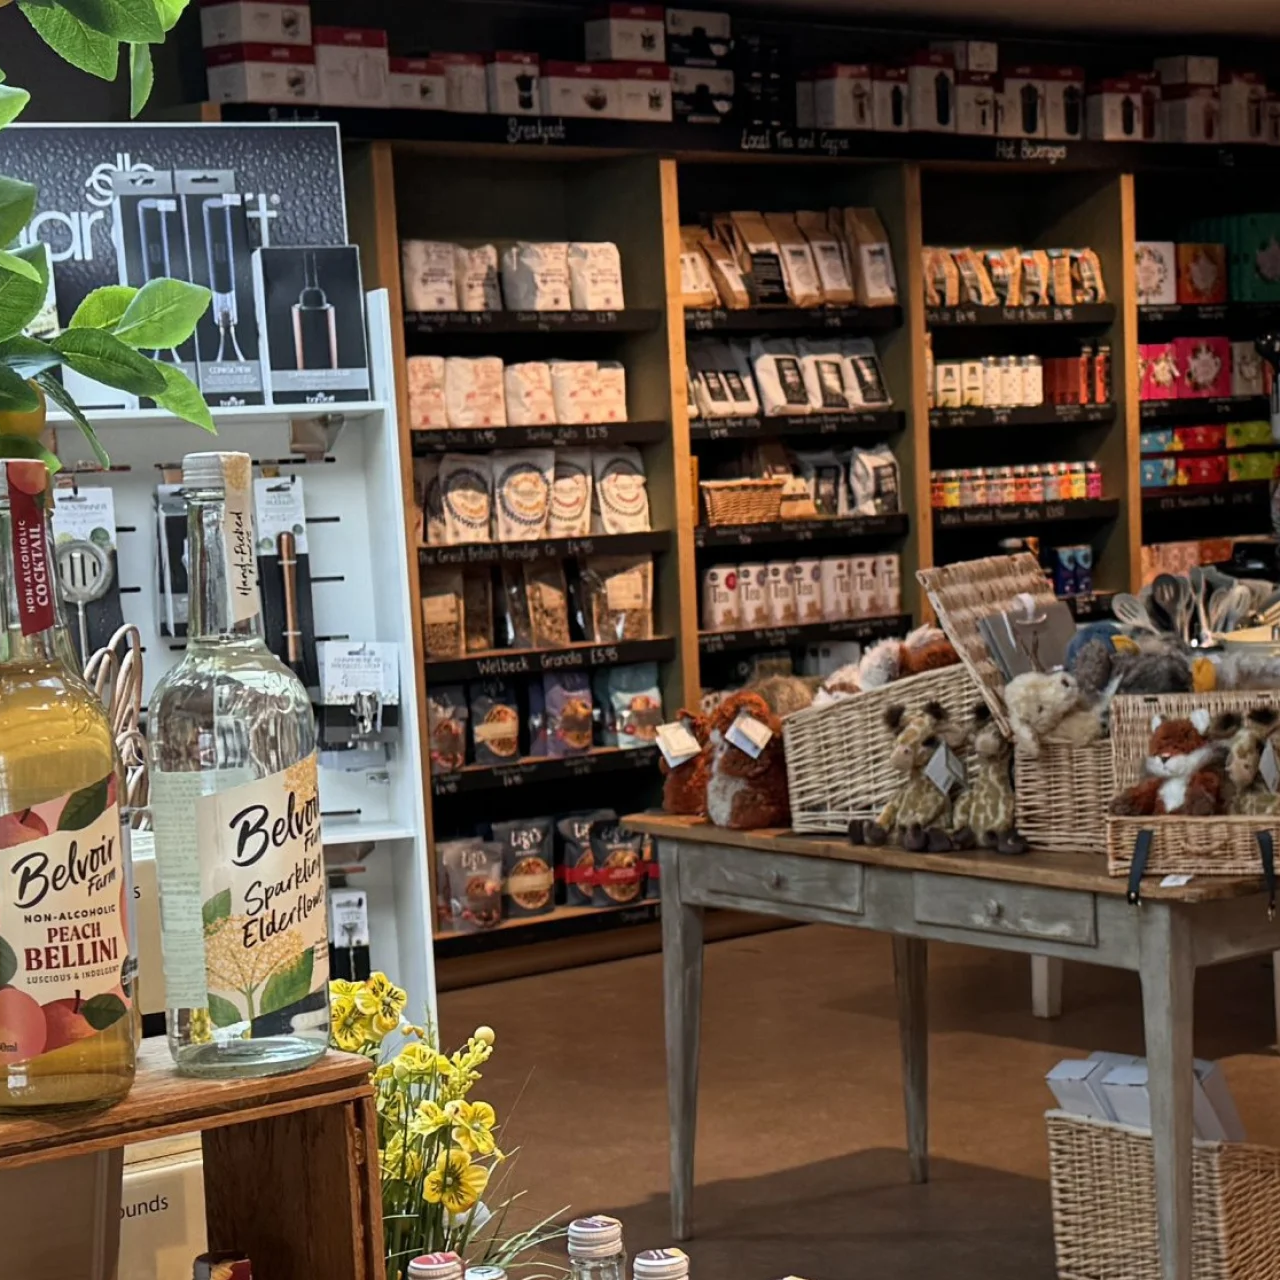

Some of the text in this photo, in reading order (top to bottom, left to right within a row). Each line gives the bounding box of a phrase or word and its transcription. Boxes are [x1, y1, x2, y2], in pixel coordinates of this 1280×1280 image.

[29, 523, 49, 607] COCKTAIL
[477, 658, 528, 674] Welbeck
[541, 651, 583, 669] Granola
[10, 835, 116, 909] Belvoir
[87, 867, 117, 897] Farm
[24, 904, 116, 924] NON-ALCOHOLIC
[242, 886, 324, 949] Elderflow
[47, 922, 101, 943] PEACH
[24, 936, 118, 972] BELLINI
[27, 973, 71, 984] LUSCIOUS
[119, 1194, 169, 1220] ounds
